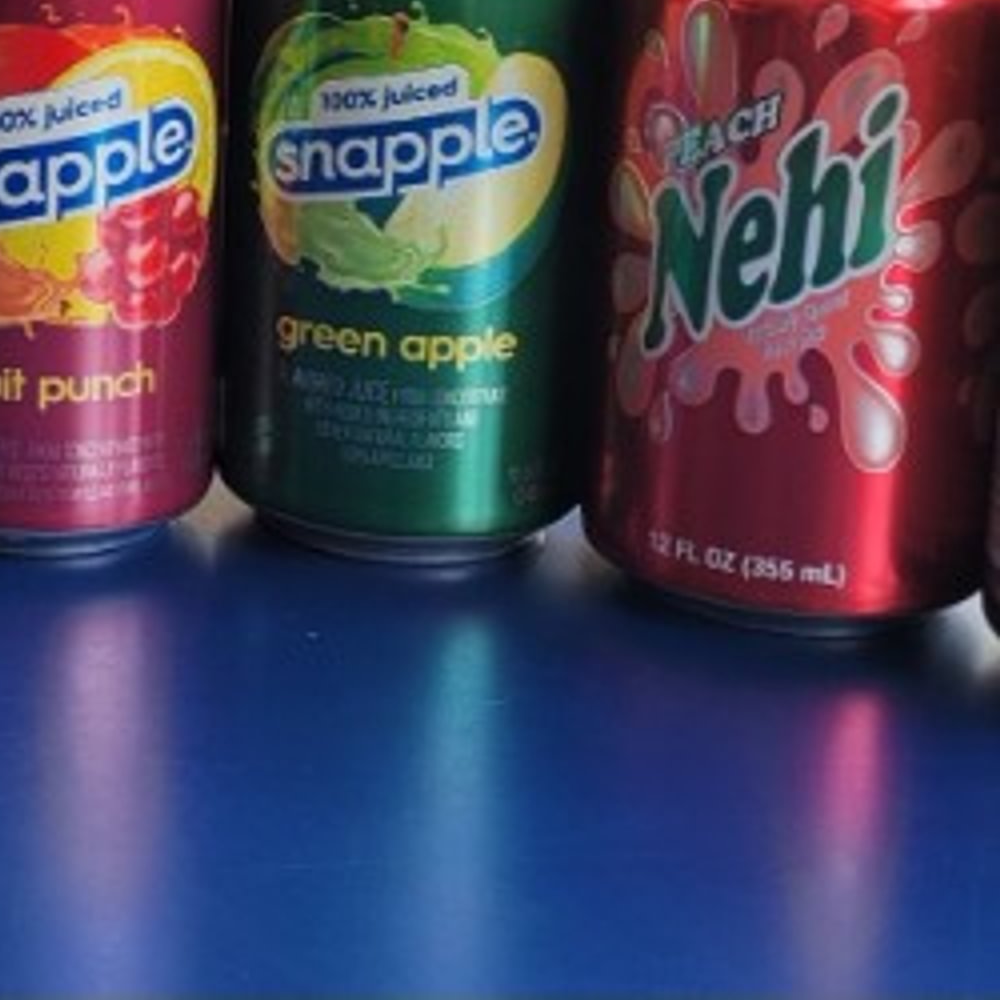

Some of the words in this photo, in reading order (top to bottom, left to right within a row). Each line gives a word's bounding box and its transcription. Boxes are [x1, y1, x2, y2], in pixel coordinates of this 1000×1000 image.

[43, 86, 123, 132] juiced
[320, 87, 377, 112] 100%
[383, 75, 459, 110] juiced
[273, 96, 530, 197] snapple
[641, 86, 907, 356] Nehi
[275, 314, 387, 352] green
[399, 327, 519, 372] apple
[38, 361, 156, 410] punch
[649, 531, 671, 557] 12
[675, 538, 700, 565] FL
[704, 546, 737, 573] OZ
[740, 554, 795, 582] (355
[800, 562, 847, 590] mL)
